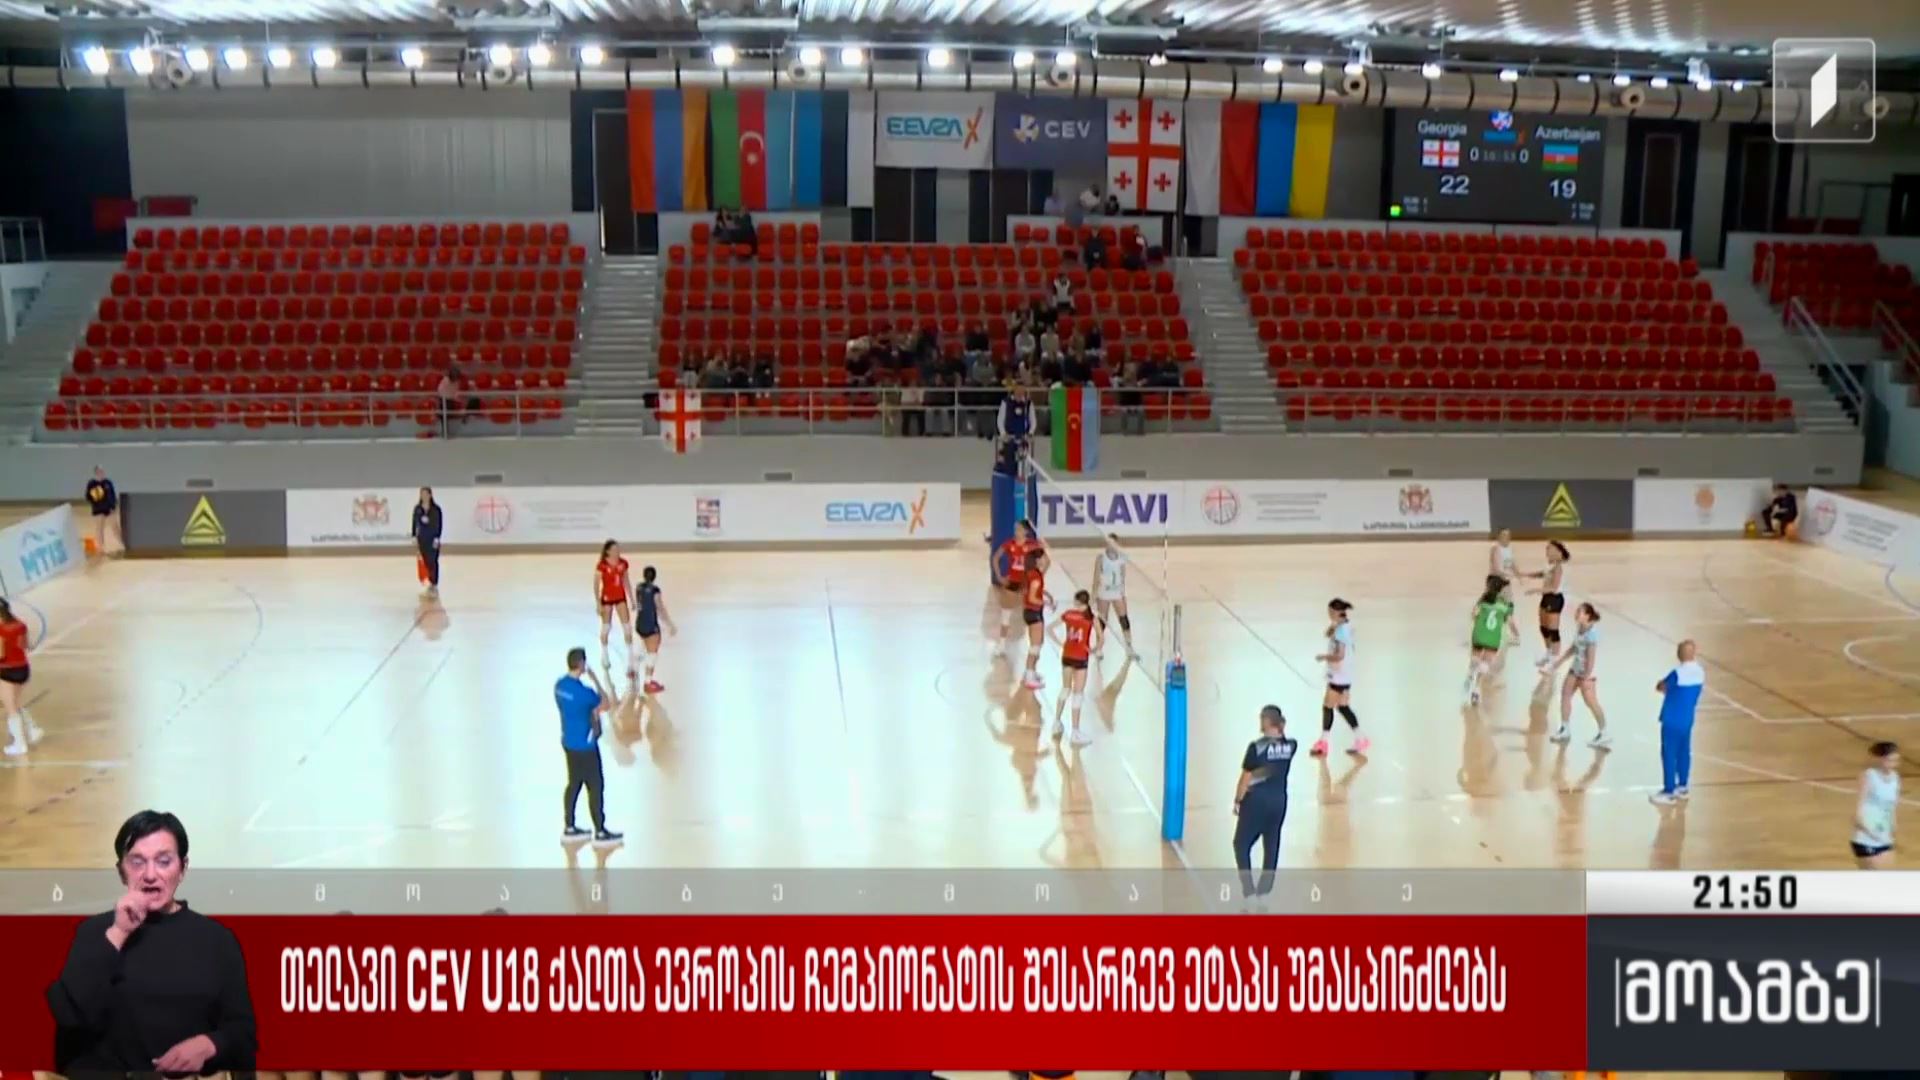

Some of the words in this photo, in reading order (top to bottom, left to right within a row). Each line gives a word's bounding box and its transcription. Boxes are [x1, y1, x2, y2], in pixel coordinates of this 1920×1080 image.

[1044, 120, 1091, 139] CEV
[1417, 121, 1468, 138] Georgia
[1535, 125, 1601, 144] Azerbaijan
[1470, 147, 1479, 162] 0
[1519, 148, 1529, 163] 0
[1440, 175, 1470, 195] 22
[1549, 179, 1577, 199] 19
[1040, 493, 1168, 525] TELAVI
[1486, 610, 1498, 631] 6
[1068, 625, 1084, 643] 14
